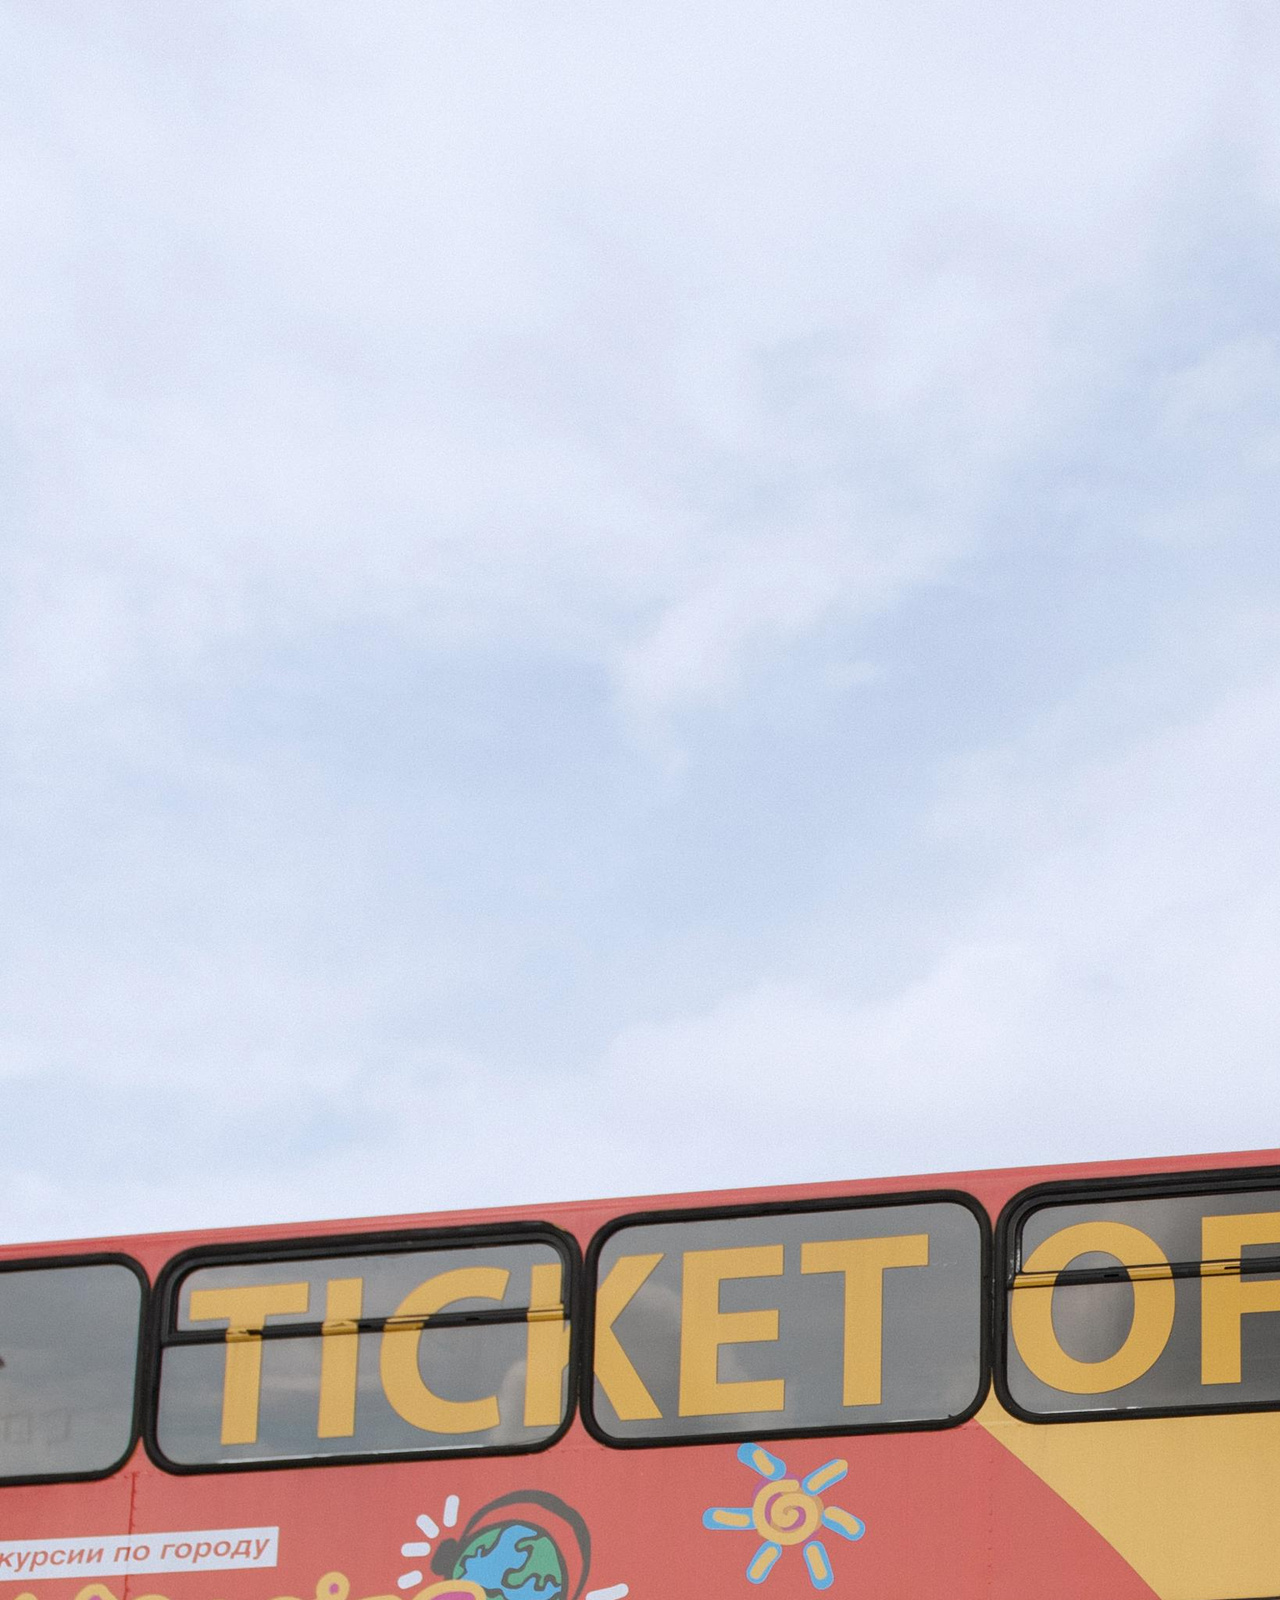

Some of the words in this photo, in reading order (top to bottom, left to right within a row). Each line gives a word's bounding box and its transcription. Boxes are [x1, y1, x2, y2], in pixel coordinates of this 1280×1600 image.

[190, 1233, 930, 1445] TICKET
[113, 1544, 150, 1563] по
[160, 1538, 270, 1564] городу
